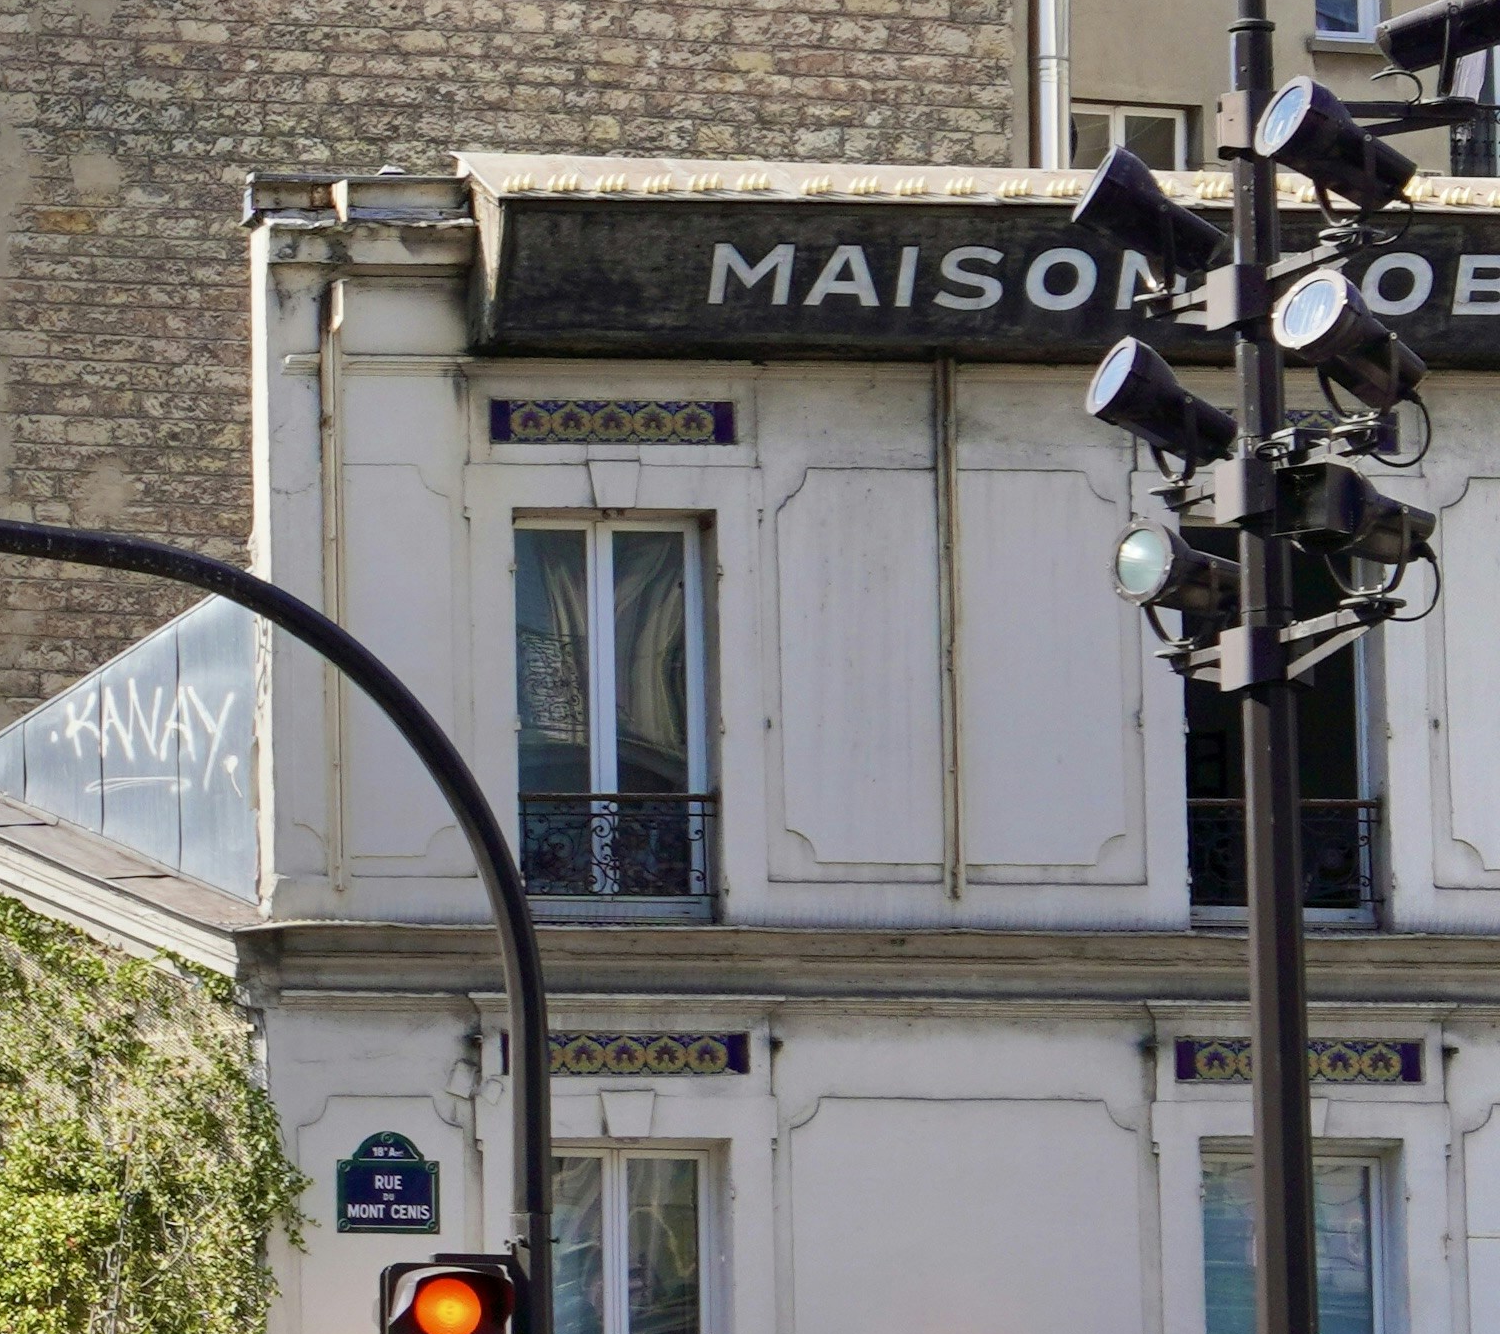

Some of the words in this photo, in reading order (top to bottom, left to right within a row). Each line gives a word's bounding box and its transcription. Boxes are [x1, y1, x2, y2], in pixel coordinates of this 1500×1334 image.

[1360, 251, 1500, 316] OB
[374, 1175, 403, 1190] RUE
[382, 1193, 396, 1201] DU
[347, 1204, 386, 1218] MONT
[390, 1204, 430, 1219] CENIS
